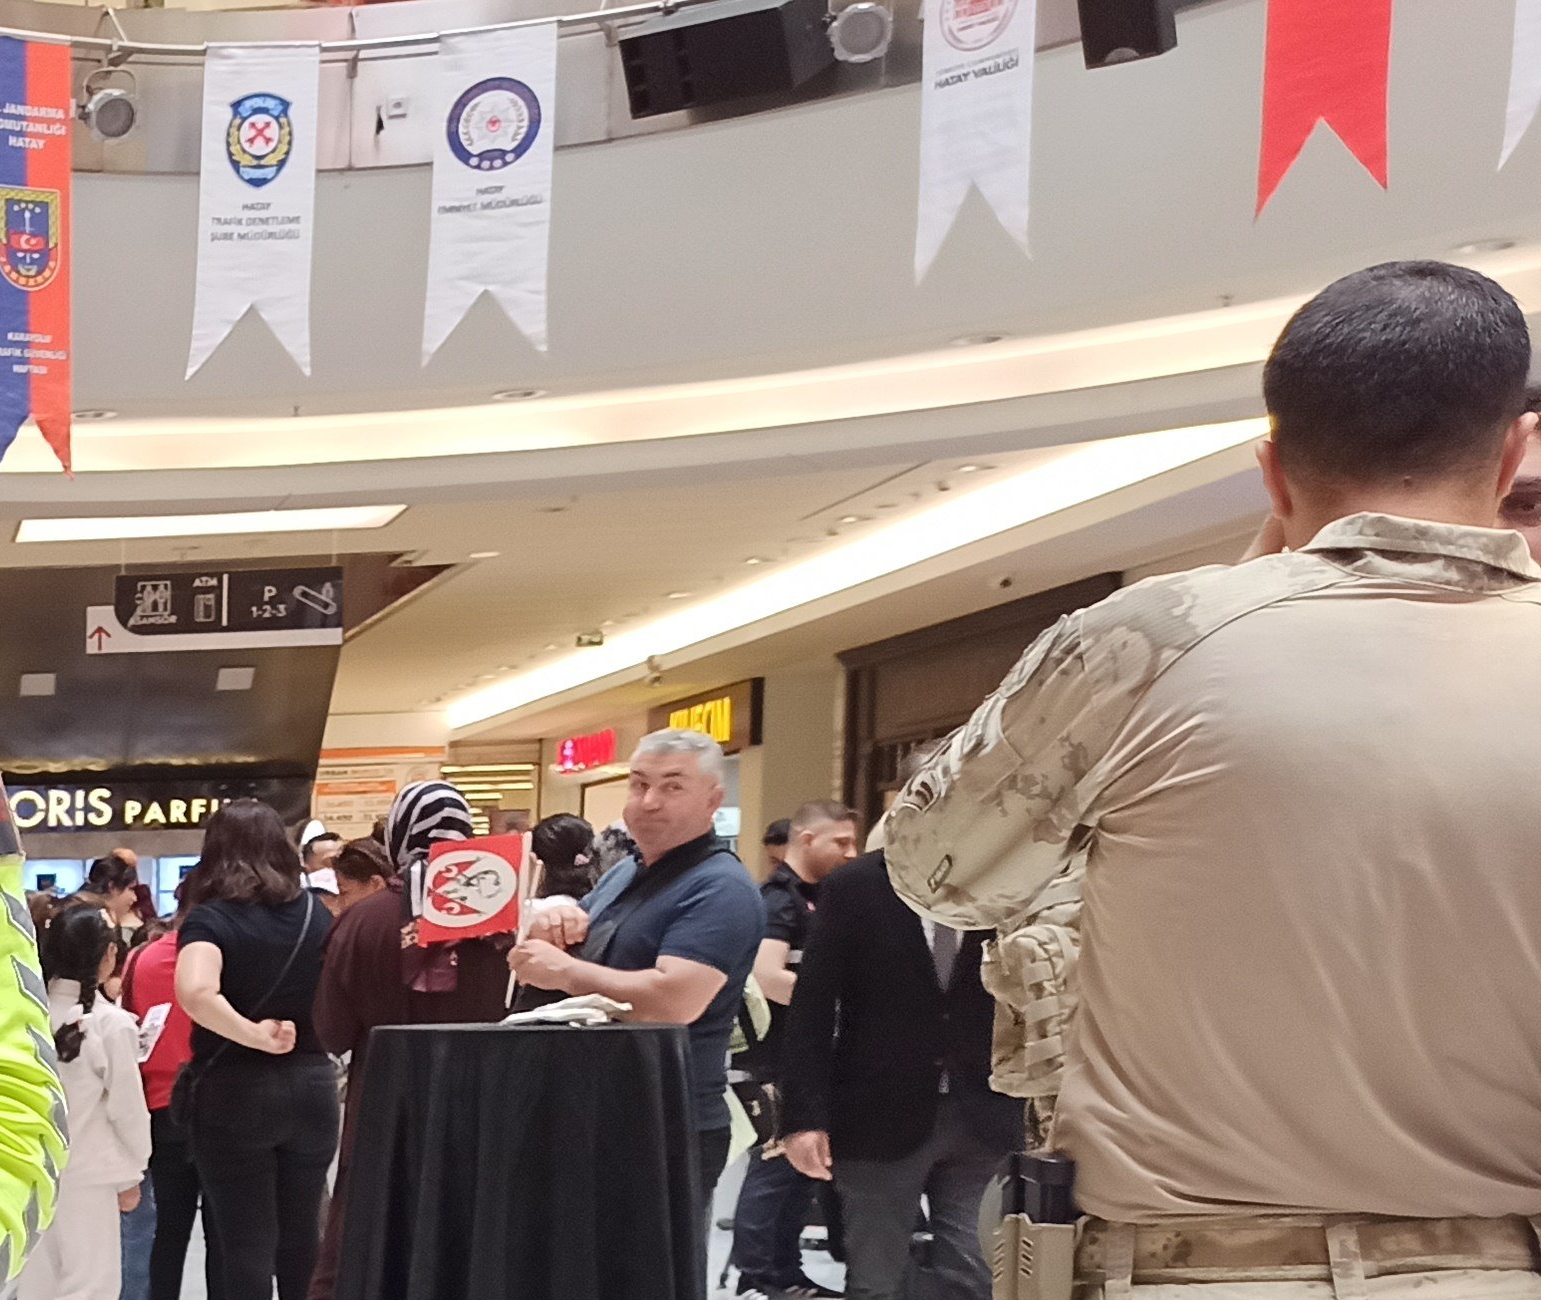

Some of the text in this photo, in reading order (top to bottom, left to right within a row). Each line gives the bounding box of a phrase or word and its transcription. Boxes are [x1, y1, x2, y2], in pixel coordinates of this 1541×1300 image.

[3, 102, 65, 119] JANDARMA
[8, 135, 45, 149] HATAY
[193, 576, 218, 587] ATM
[263, 585, 277, 602] P
[124, 798, 231, 826] PARF
